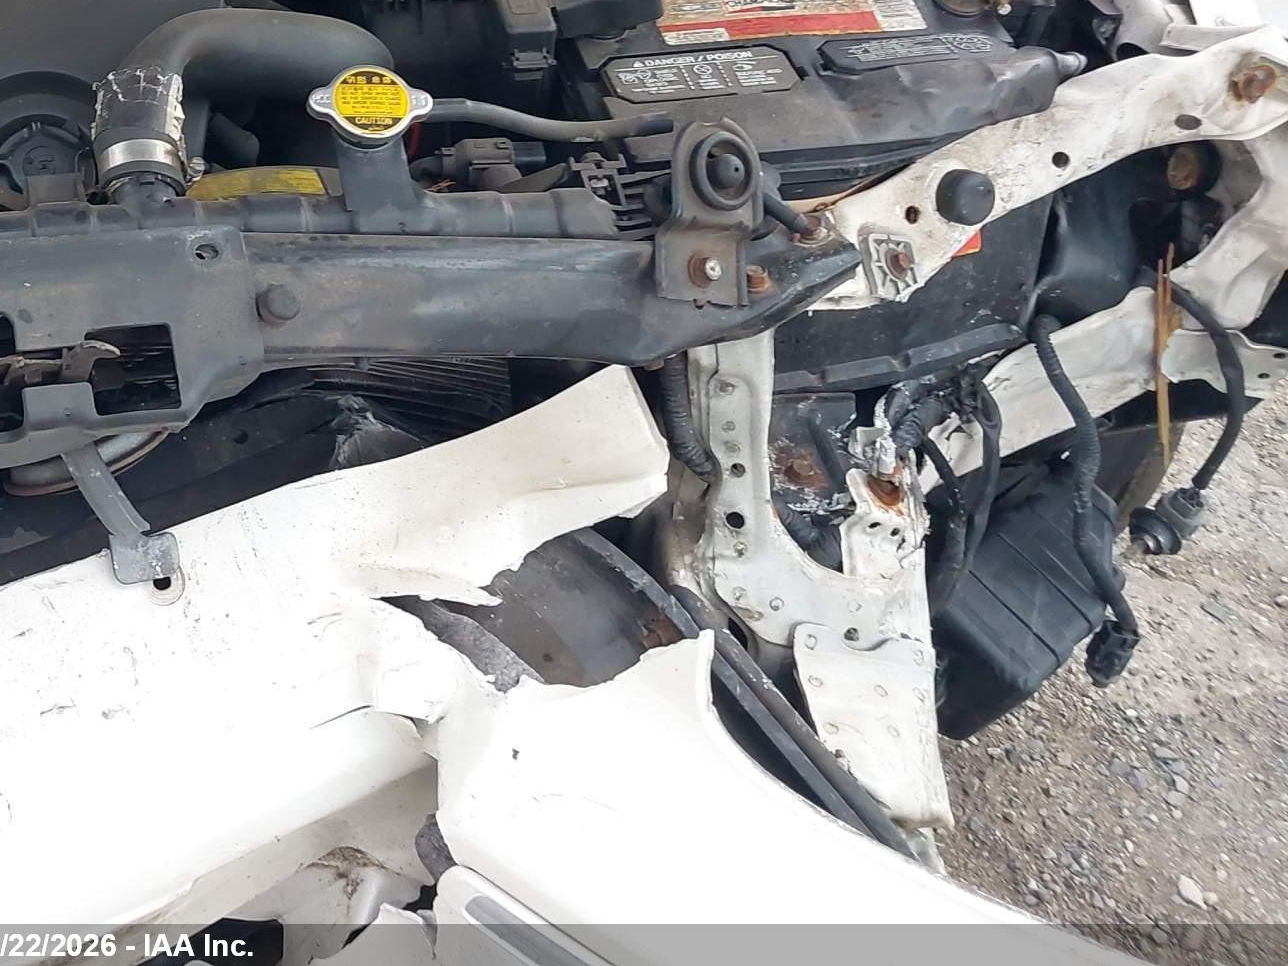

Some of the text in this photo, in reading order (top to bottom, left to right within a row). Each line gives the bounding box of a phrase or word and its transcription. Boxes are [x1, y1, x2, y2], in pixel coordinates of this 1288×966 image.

[644, 56, 695, 67] DANGER
[705, 51, 753, 61] POISON
[354, 116, 393, 125] CAUTION
